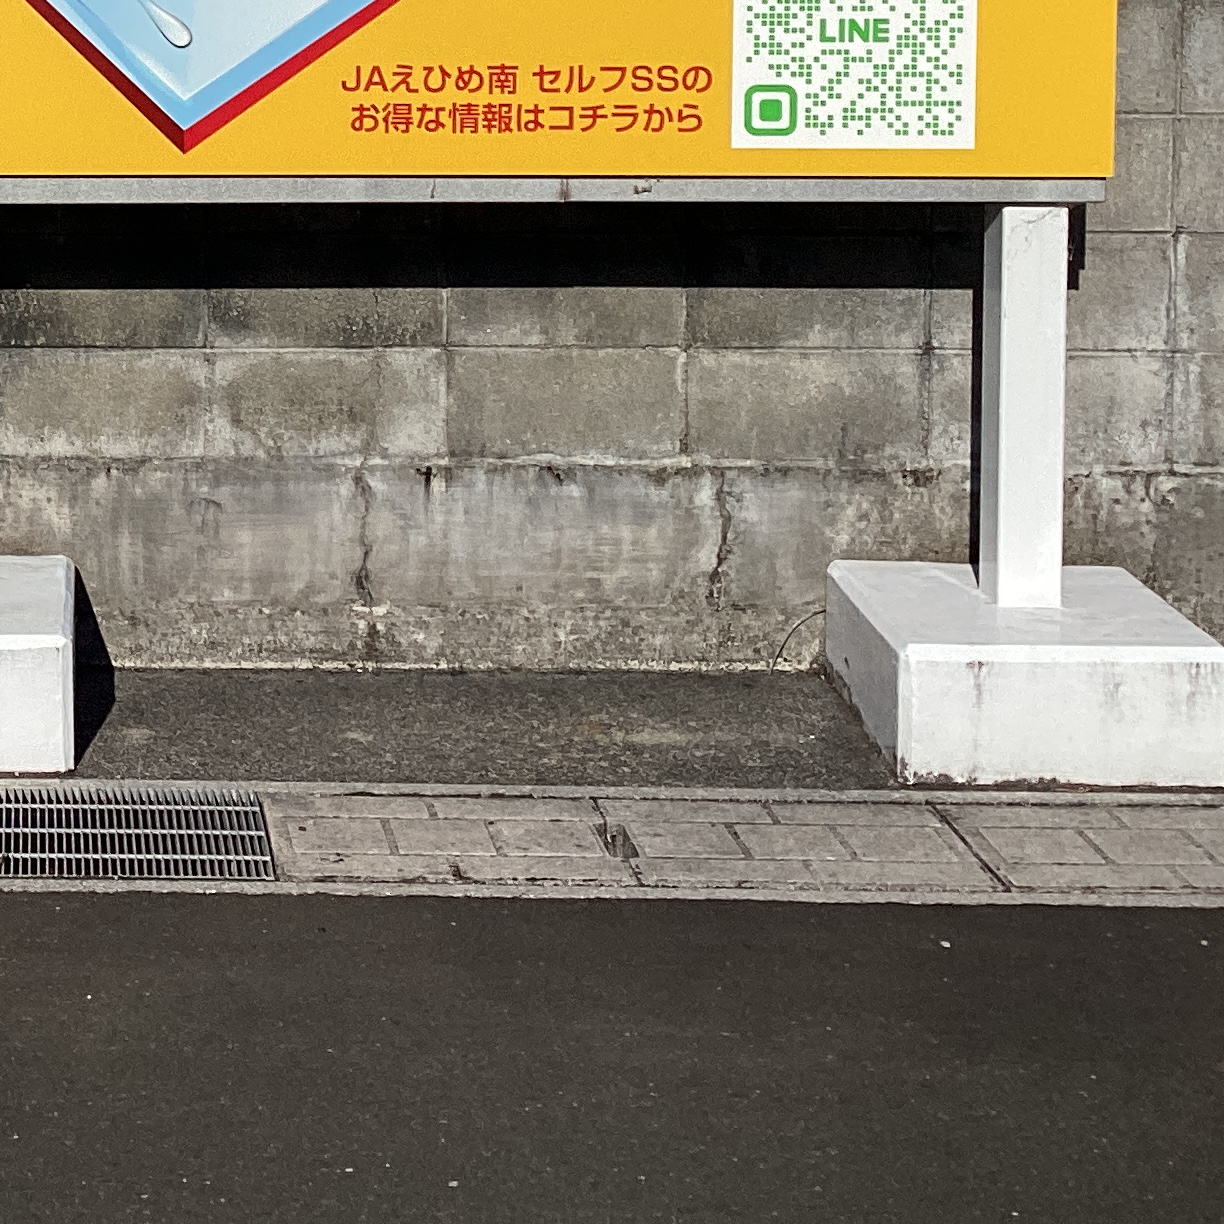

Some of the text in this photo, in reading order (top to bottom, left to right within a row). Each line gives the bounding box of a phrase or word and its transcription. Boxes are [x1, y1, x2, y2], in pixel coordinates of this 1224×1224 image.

[819, 17, 890, 43] LINE
[341, 63, 713, 95] JAえひめ南 セルフSSの
[350, 102, 704, 135] お得な情報はコチラから
